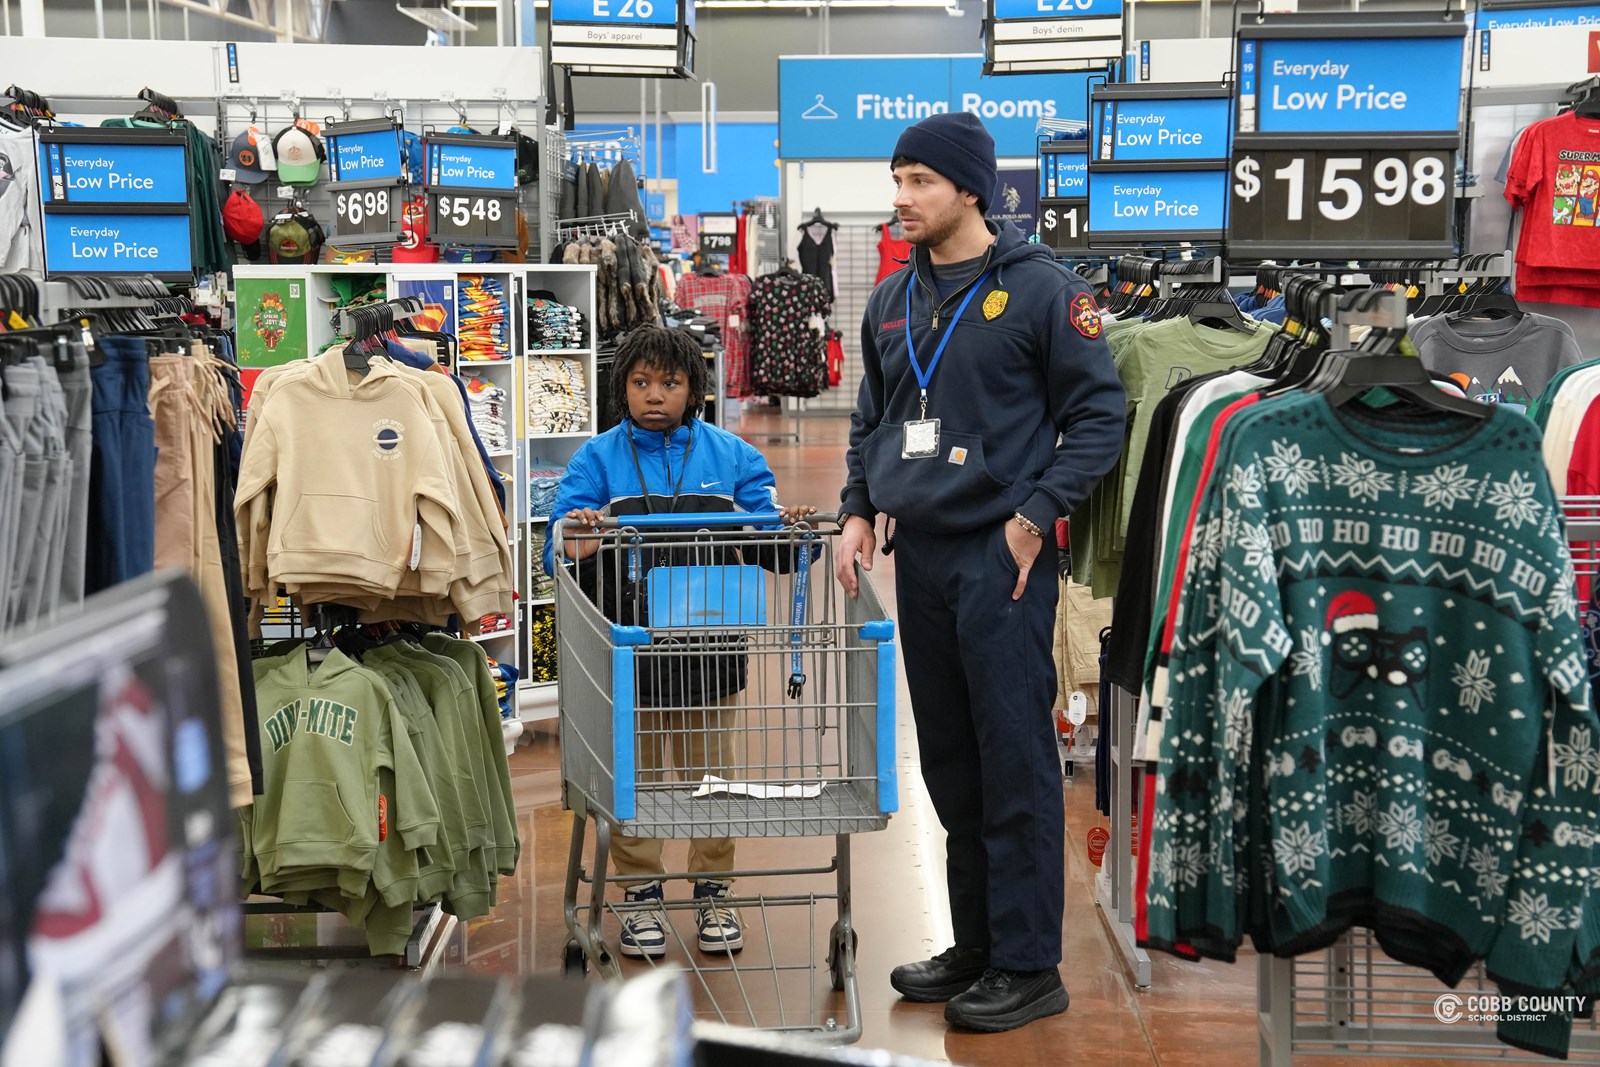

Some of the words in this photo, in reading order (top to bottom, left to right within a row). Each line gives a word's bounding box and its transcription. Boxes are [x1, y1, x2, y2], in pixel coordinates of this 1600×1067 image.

[593, 0, 610, 16] E
[617, 0, 653, 18] 26
[587, 31, 610, 40] Boys'
[611, 32, 642, 41] apparel
[1032, 26, 1055, 36] Boys'
[1057, 25, 1084, 34] denim
[1245, 44, 1252, 53] E
[1243, 63, 1254, 72] 19
[1273, 60, 1350, 79] Everyday
[1245, 81, 1250, 90] 1
[1272, 85, 1328, 110] Low
[1336, 84, 1407, 110] Price
[856, 94, 948, 120] Fitting
[962, 93, 1057, 118] Rooms
[1117, 113, 1165, 126] Everyday
[1117, 129, 1152, 146] Low
[1158, 129, 1202, 145] Price
[338, 145, 363, 154] Everyday
[1559, 150, 1590, 161] SUPER
[65, 157, 114, 169] Everyday
[340, 158, 358, 170] Low
[361, 155, 384, 168] Price
[441, 154, 472, 163] Everyday
[442, 165, 464, 177] Low
[467, 166, 495, 179] Price
[67, 173, 102, 189] Low
[108, 173, 154, 189] Price
[1059, 175, 1084, 186] Low
[1113, 185, 1162, 197] Everyday
[1114, 200, 1149, 217] Low
[1154, 200, 1199, 216] Price
[1044, 208, 1088, 238] $1
[70, 227, 120, 239] Everyday
[72, 242, 108, 258] Low
[114, 242, 158, 258] Price
[1297, 518, 1324, 543] HO
[1332, 519, 1370, 545] HO
[1380, 524, 1420, 551] HO
[1428, 530, 1466, 558] HO
[1471, 540, 1507, 573] HO
[1509, 558, 1547, 596] HO
